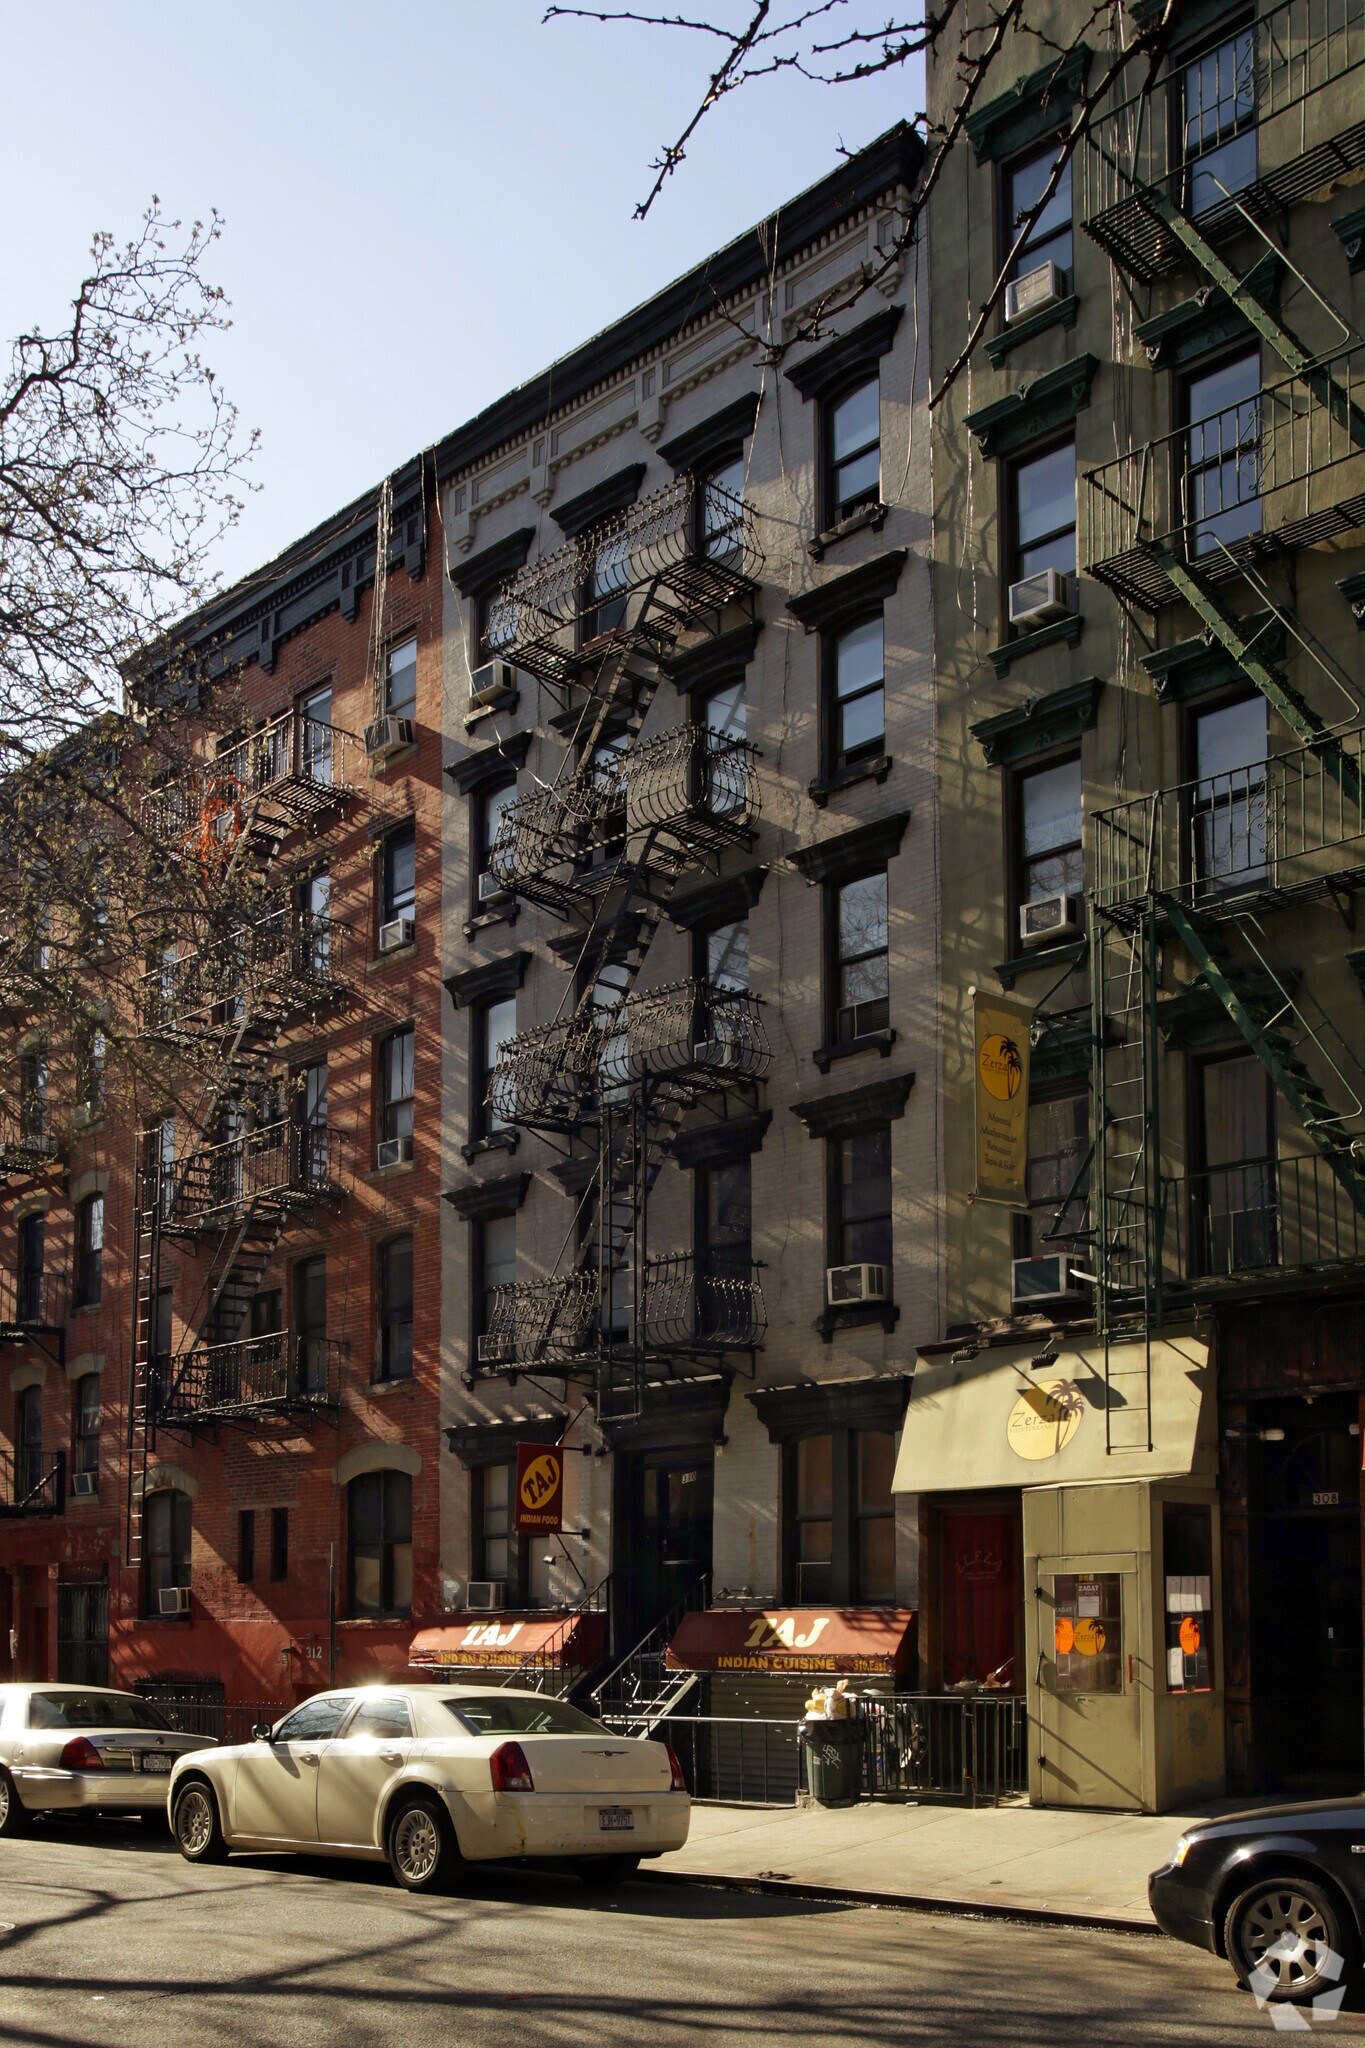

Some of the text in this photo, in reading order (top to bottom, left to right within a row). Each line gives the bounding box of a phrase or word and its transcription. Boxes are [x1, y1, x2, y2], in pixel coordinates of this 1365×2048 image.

[982, 1053, 1008, 1072] Zerza
[1012, 1411, 1055, 1428] Zerza
[523, 1458, 557, 1505] TAJ
[1314, 1493, 1338, 1504] 308
[520, 1513, 559, 1525] INDIAN FOOD
[460, 1619, 525, 1646] TAJ
[744, 1617, 830, 1648] TAJ
[306, 1645, 323, 1659] 312
[440, 1653, 476, 1664] INDAN
[478, 1654, 523, 1665] CUISINE
[718, 1656, 768, 1669] INDIAN
[772, 1658, 836, 1671] CUISINE
